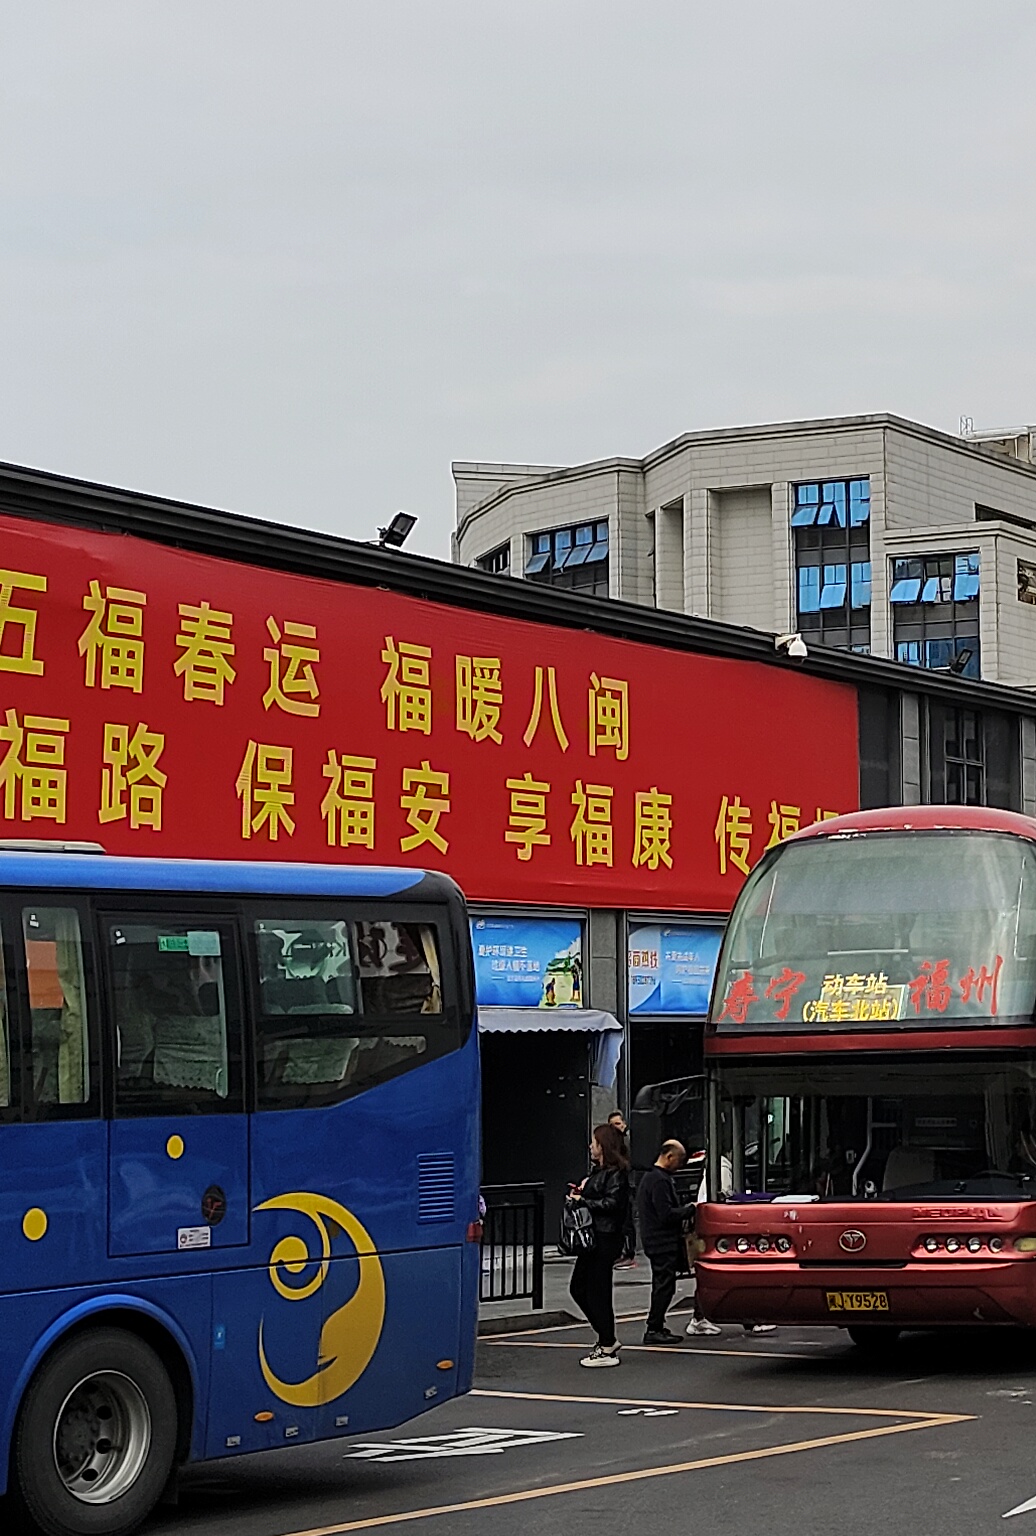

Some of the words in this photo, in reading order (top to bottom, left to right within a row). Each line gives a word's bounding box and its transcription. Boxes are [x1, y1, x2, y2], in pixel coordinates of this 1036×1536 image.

[0, 569, 320, 717] 五福春运
[381, 636, 629, 761] 福暖八闽
[0, 709, 168, 831] 福路
[235, 740, 450, 855] 保福安
[504, 773, 672, 870] 享福康
[715, 795, 839, 876] 传福
[717, 967, 806, 1024] 寿宁
[822, 973, 889, 994] 动车站
[908, 955, 1003, 1016] 福州
